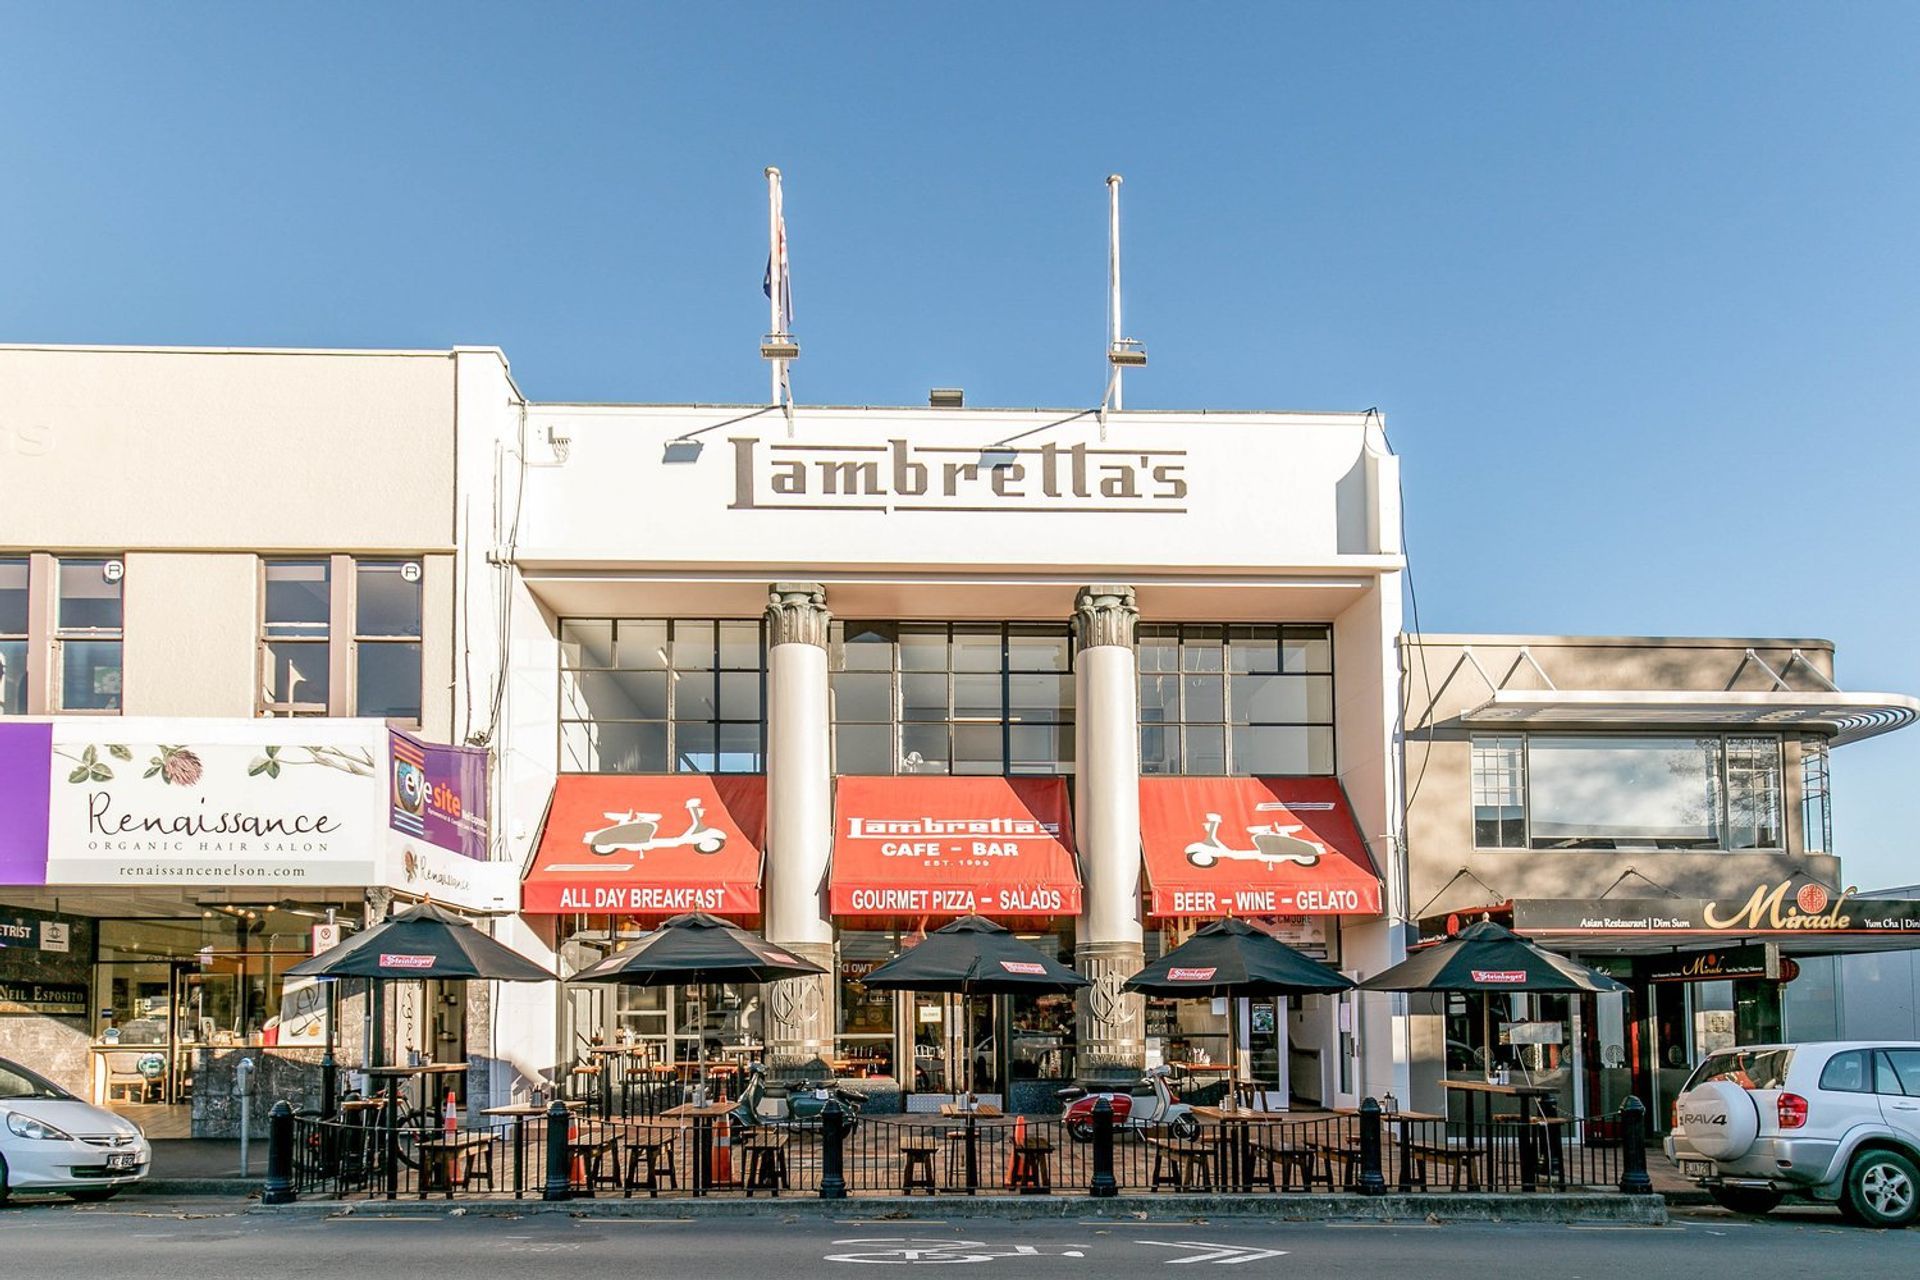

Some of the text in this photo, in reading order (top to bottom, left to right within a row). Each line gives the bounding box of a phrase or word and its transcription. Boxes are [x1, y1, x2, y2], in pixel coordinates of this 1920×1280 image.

[88, 791, 342, 837] Renaissance
[88, 840, 329, 852] ORGANIC HAIR SALON
[881, 843, 940, 857] CAFE
[972, 843, 1018, 857] BAR
[120, 864, 306, 878] renaissancenelson.com
[560, 888, 725, 909] ALL DAY BREAKFAST
[851, 889, 929, 910] GOURMET
[932, 890, 976, 910] PIZZA
[999, 889, 1061, 909] SALADS
[1173, 892, 1217, 912] BEER
[1235, 892, 1276, 911] WINE
[1296, 890, 1358, 910] GELATO
[1703, 879, 1858, 930] Miracle
[1580, 917, 1602, 928] Asian
[1604, 917, 1647, 928] Restaurant
[1653, 918, 1671, 928] Dim
[1672, 918, 1690, 928] Sum
[1863, 918, 1882, 928] Yum
[1883, 918, 1900, 928] Cha
[34, 986, 84, 1002] ESPOSITO
[1684, 1113, 1727, 1126] RAV4
